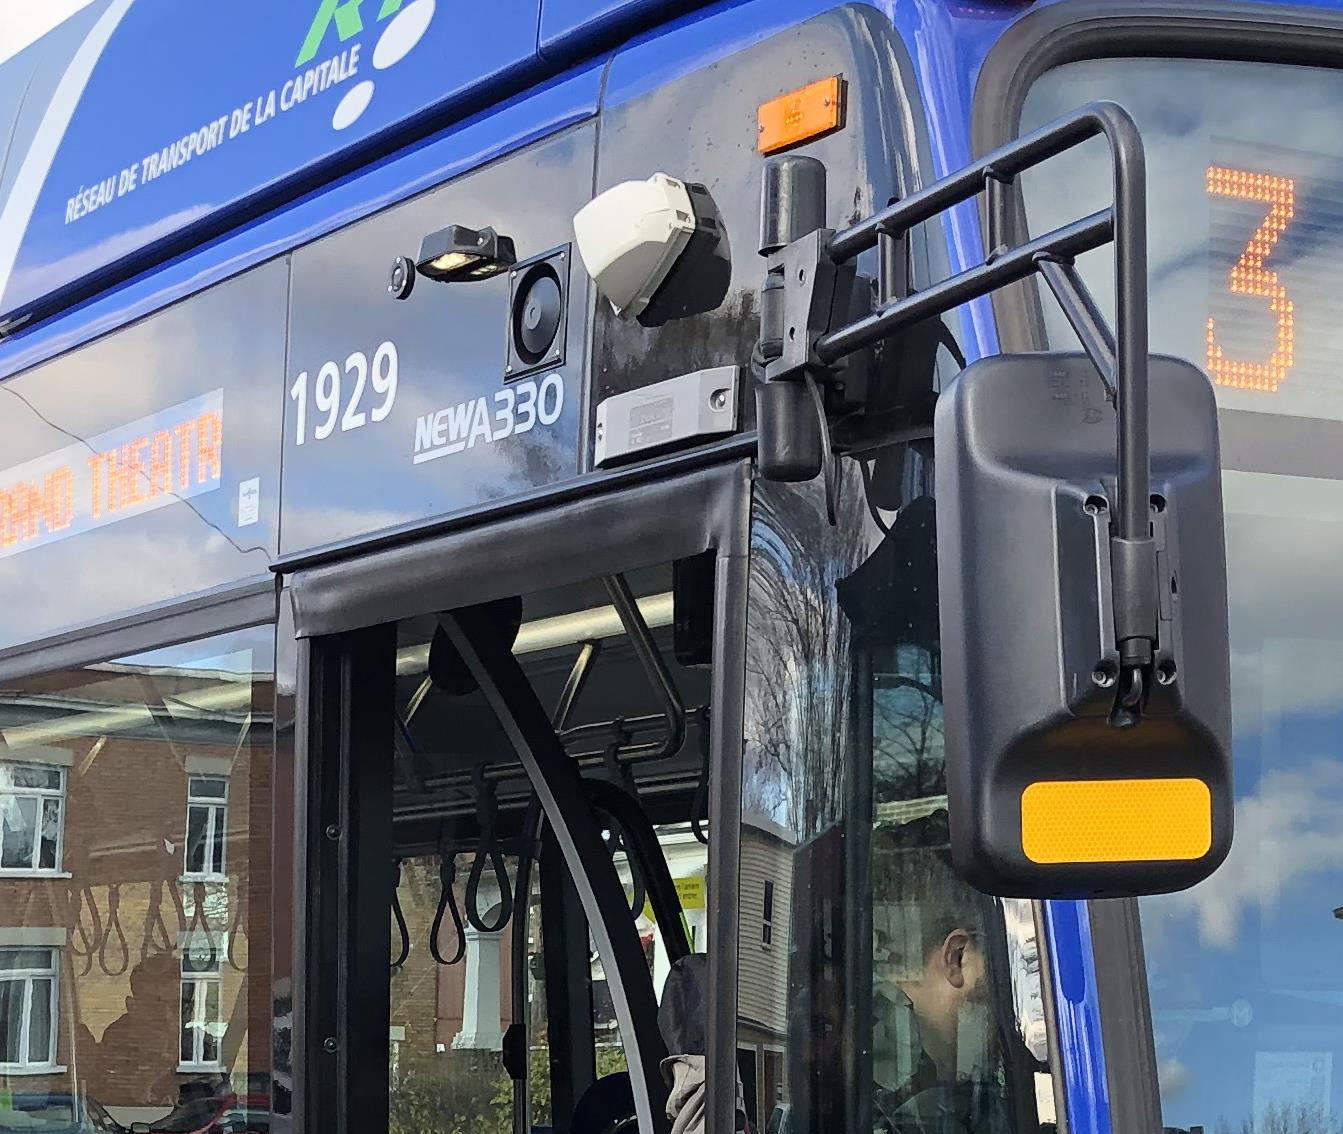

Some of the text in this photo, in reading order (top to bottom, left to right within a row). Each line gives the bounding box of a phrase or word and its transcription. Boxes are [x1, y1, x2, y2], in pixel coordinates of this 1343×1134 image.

[65, 43, 362, 225] RÉSEAU DE TRANSPORT DE LA CAPITALE
[1205, 164, 1295, 393] 3
[290, 340, 398, 446] 1929
